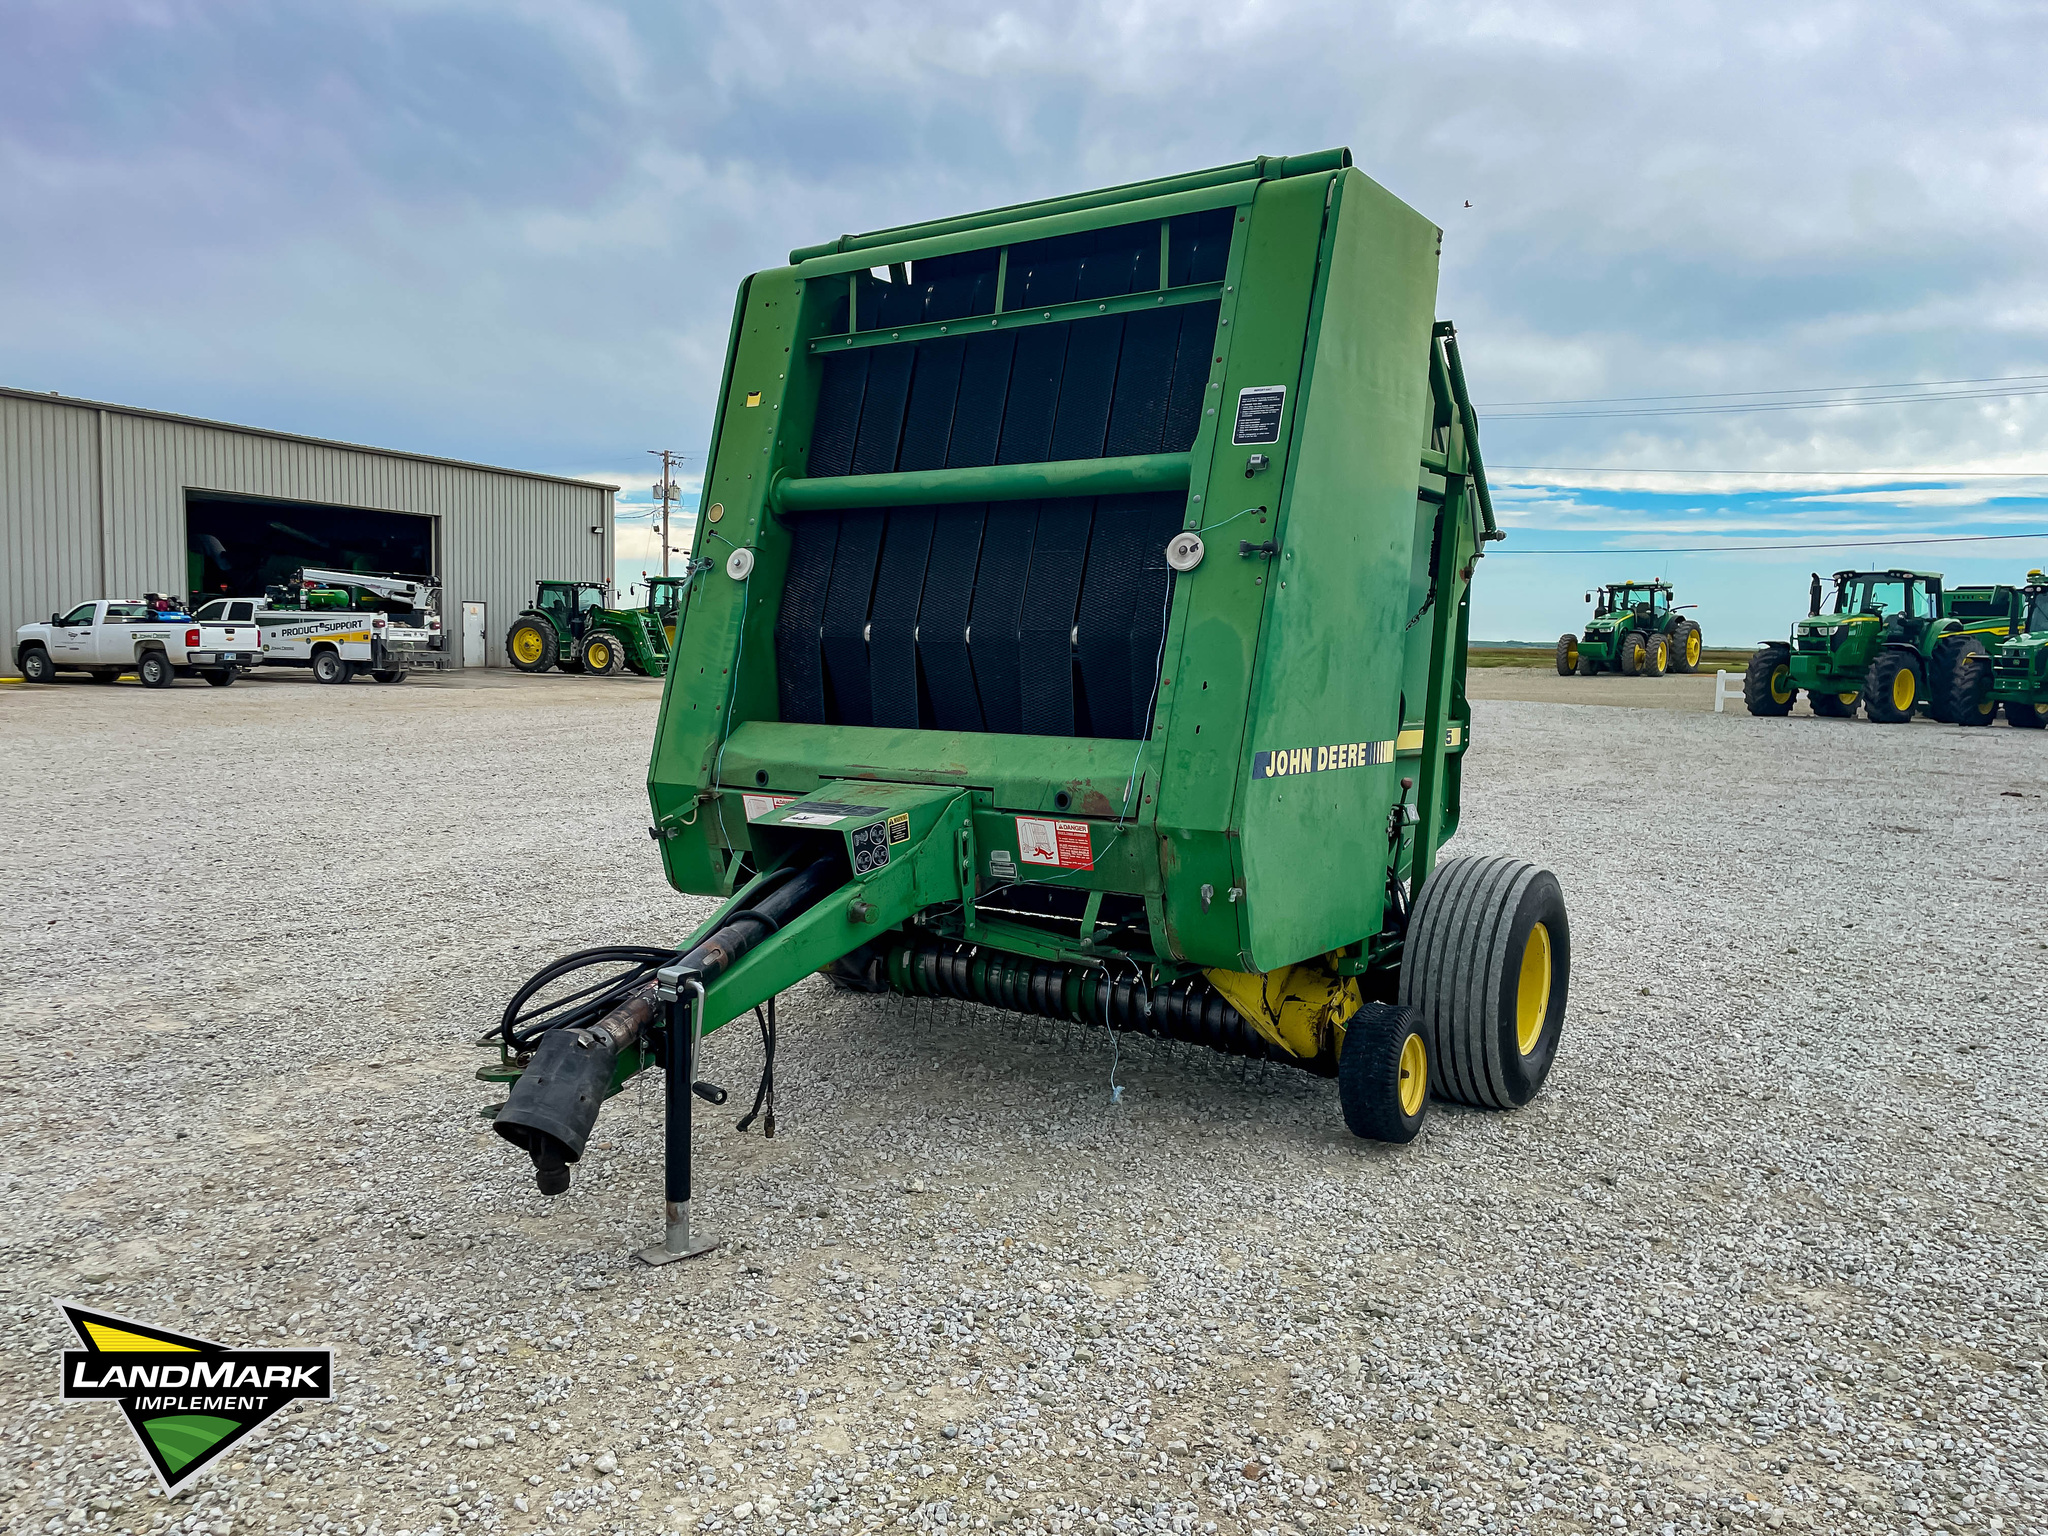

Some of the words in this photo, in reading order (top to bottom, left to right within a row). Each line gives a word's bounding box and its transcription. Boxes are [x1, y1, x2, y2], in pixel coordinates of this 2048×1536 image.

[281, 626, 319, 637] PRODUCT
[324, 620, 363, 632] SUPPORT
[1265, 747, 1313, 778] JOHN
[1317, 742, 1367, 772] DEERE
